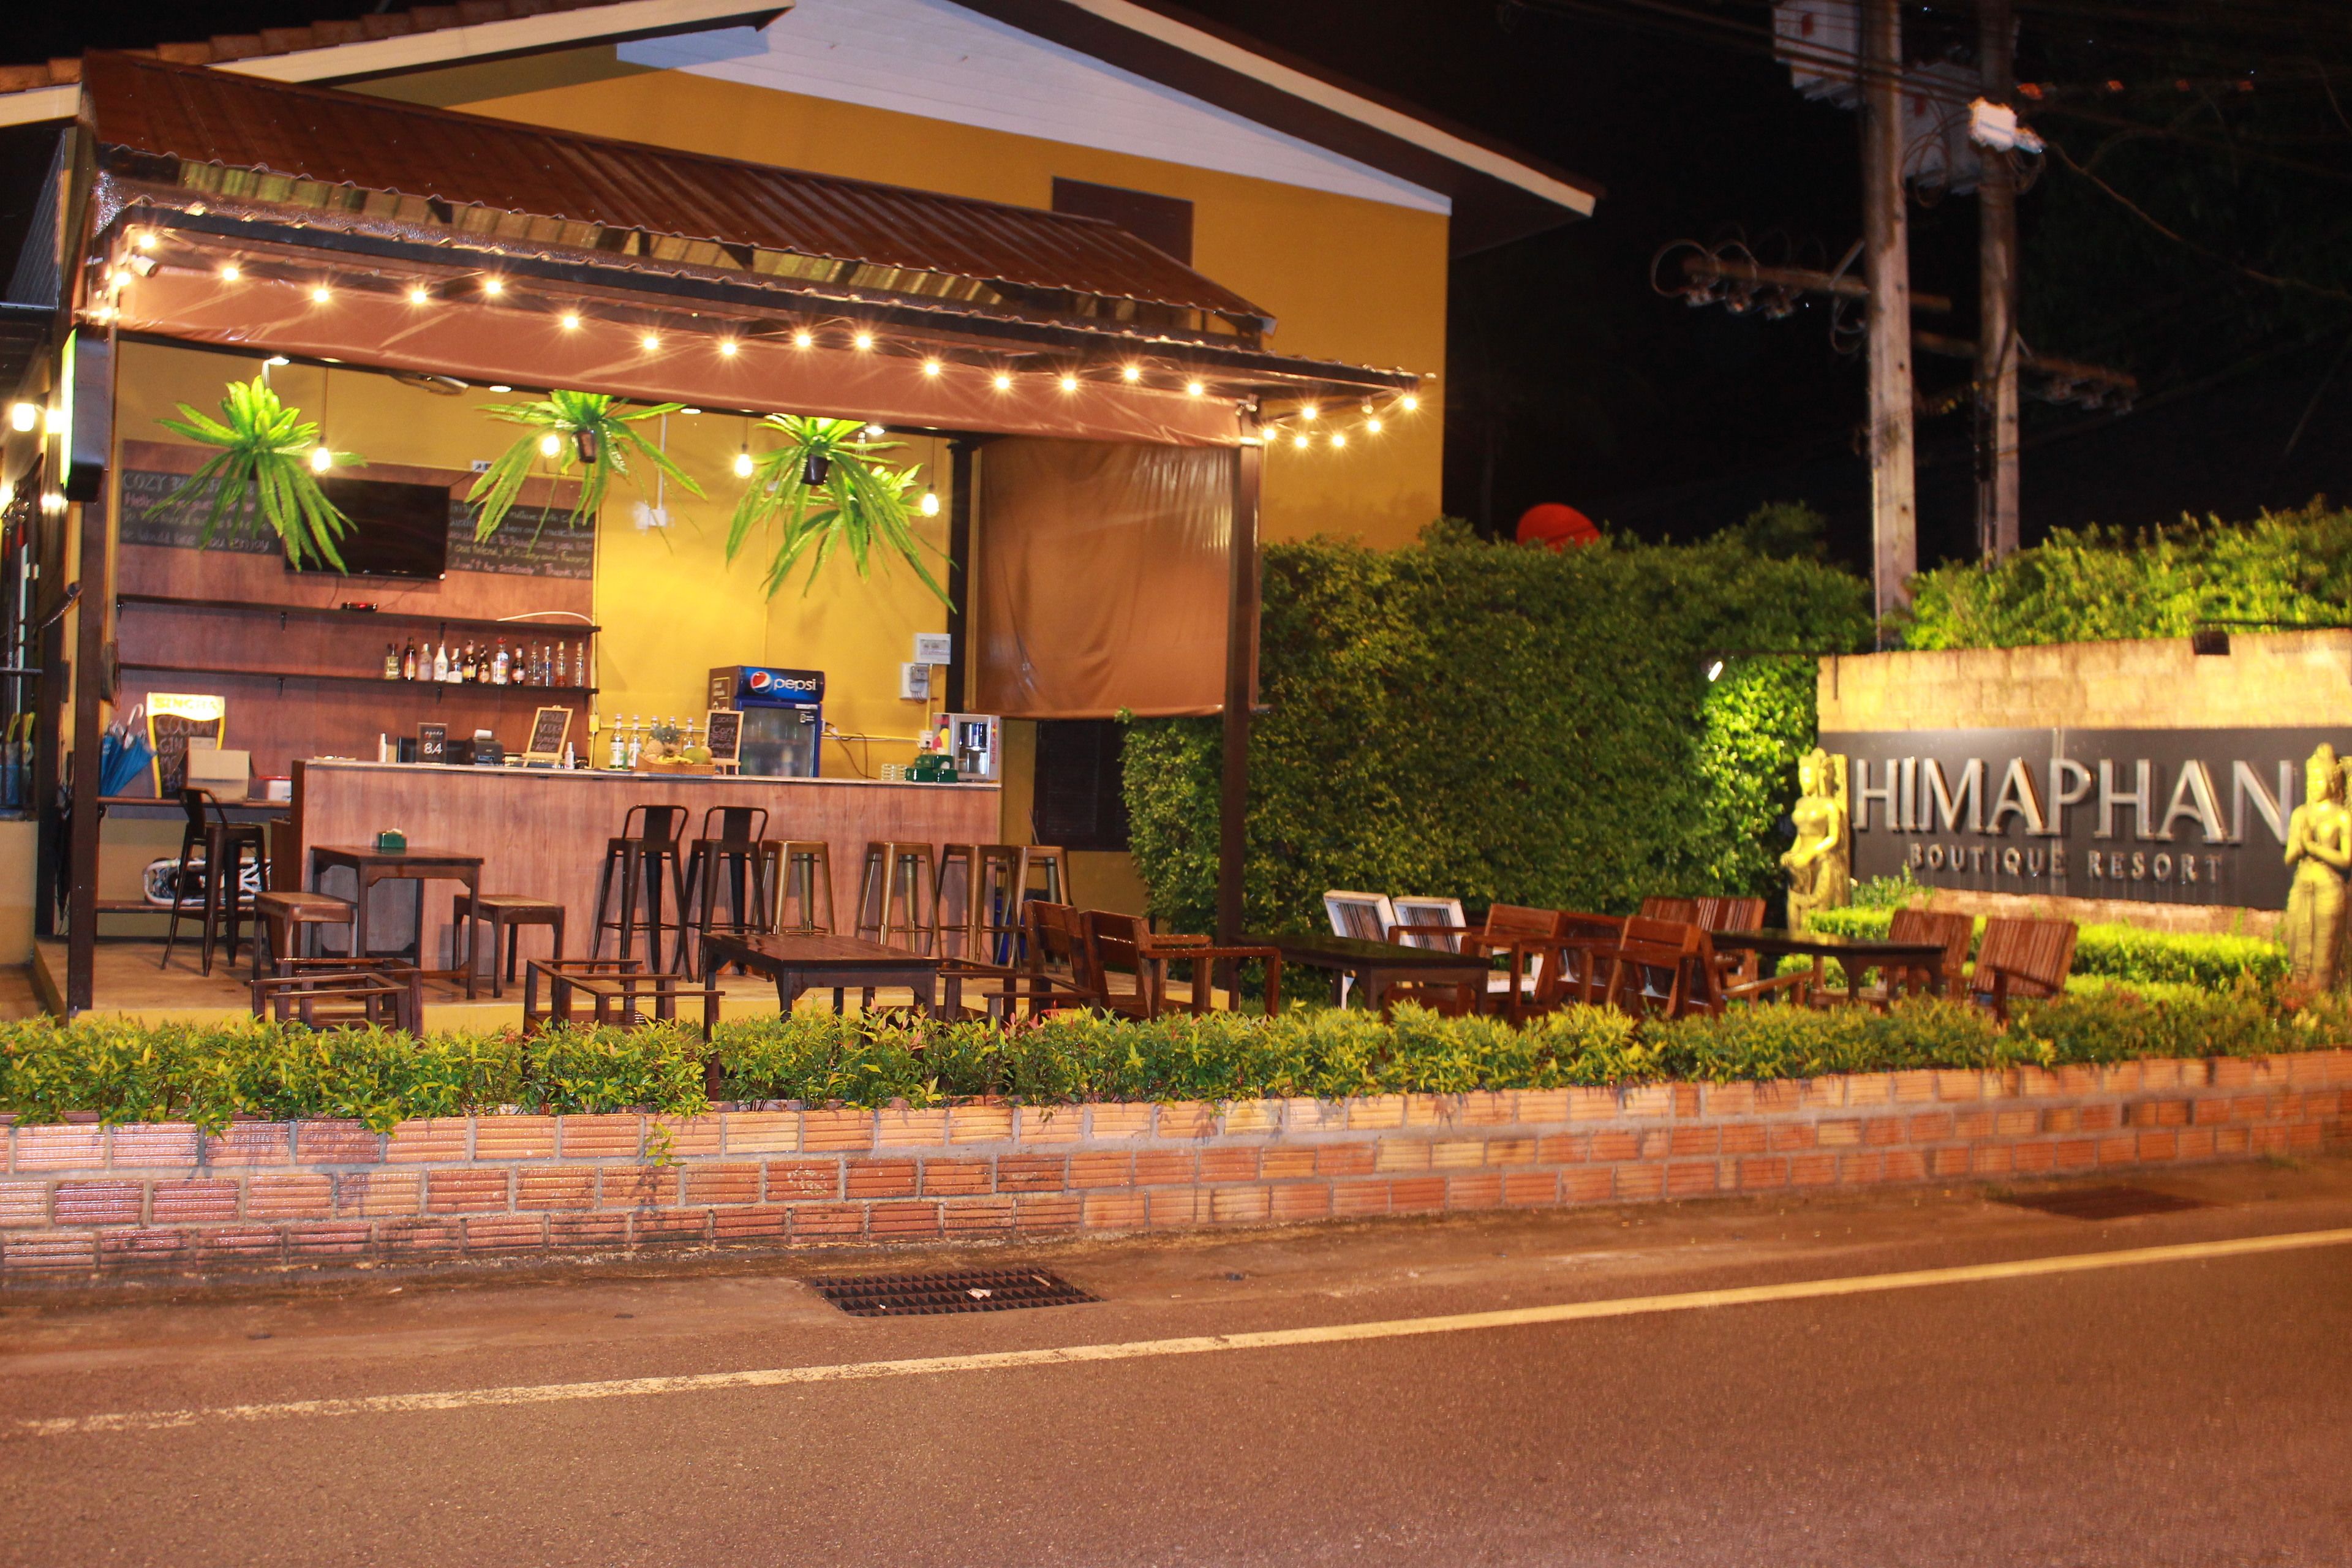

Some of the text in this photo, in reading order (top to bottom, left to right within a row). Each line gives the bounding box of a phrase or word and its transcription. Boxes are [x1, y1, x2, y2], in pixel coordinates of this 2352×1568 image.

[124, 472, 167, 492] COZY
[774, 678, 817, 692] pepsi
[1852, 756, 2294, 845] HIMAPHAN
[1909, 842, 2223, 883] BOUTIQUE RESORT
